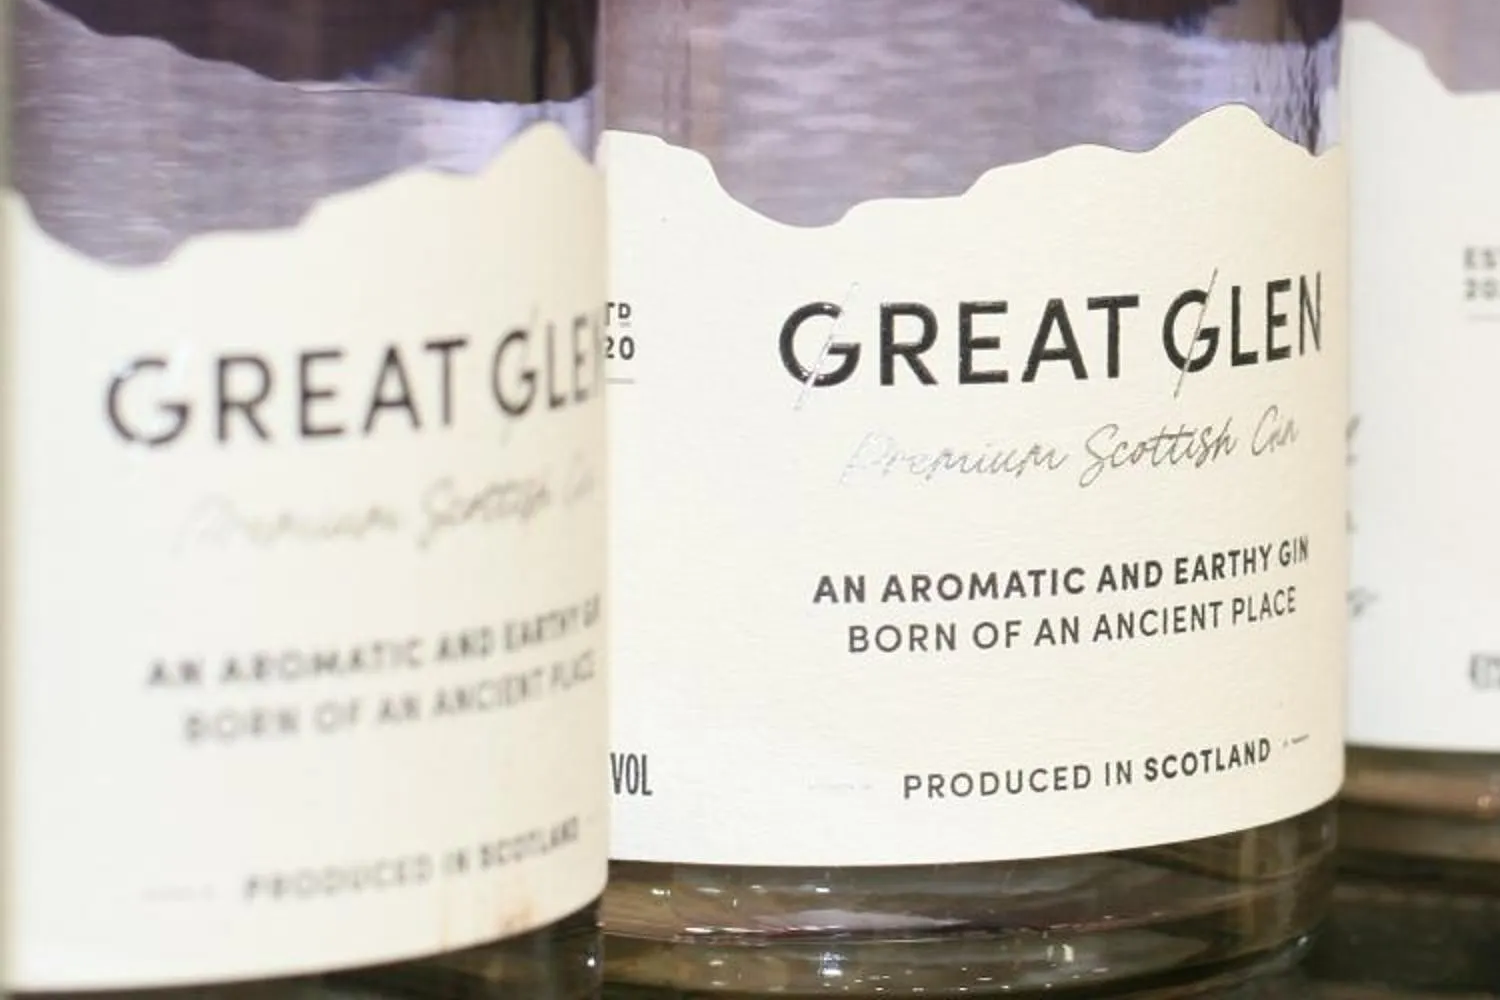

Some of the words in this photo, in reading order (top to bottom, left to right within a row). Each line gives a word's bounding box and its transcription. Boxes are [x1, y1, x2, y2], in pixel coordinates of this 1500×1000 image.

[779, 294, 1140, 388] GREAT
[1162, 269, 1322, 392] GLEN
[104, 336, 468, 447] GREAT
[838, 428, 1071, 488] Premium
[1078, 415, 1238, 489] Scottish
[813, 574, 866, 604] AN
[880, 566, 1086, 602] AROMATIC
[1096, 560, 1163, 594] AND
[1174, 544, 1272, 586] EARTHY
[1279, 535, 1310, 568] GIN
[848, 623, 957, 654] BORN
[972, 620, 1023, 651] OF
[1034, 615, 1080, 647] AN
[1092, 600, 1224, 643] ANCIENT
[1231, 586, 1297, 626] PLACE
[147, 656, 203, 689] AN
[219, 635, 423, 686] AROMATIC
[609, 752, 654, 797] VOL
[903, 764, 1092, 800] PRODUCED
[1104, 760, 1132, 787] IN
[1144, 737, 1271, 782] SCOTLAND
